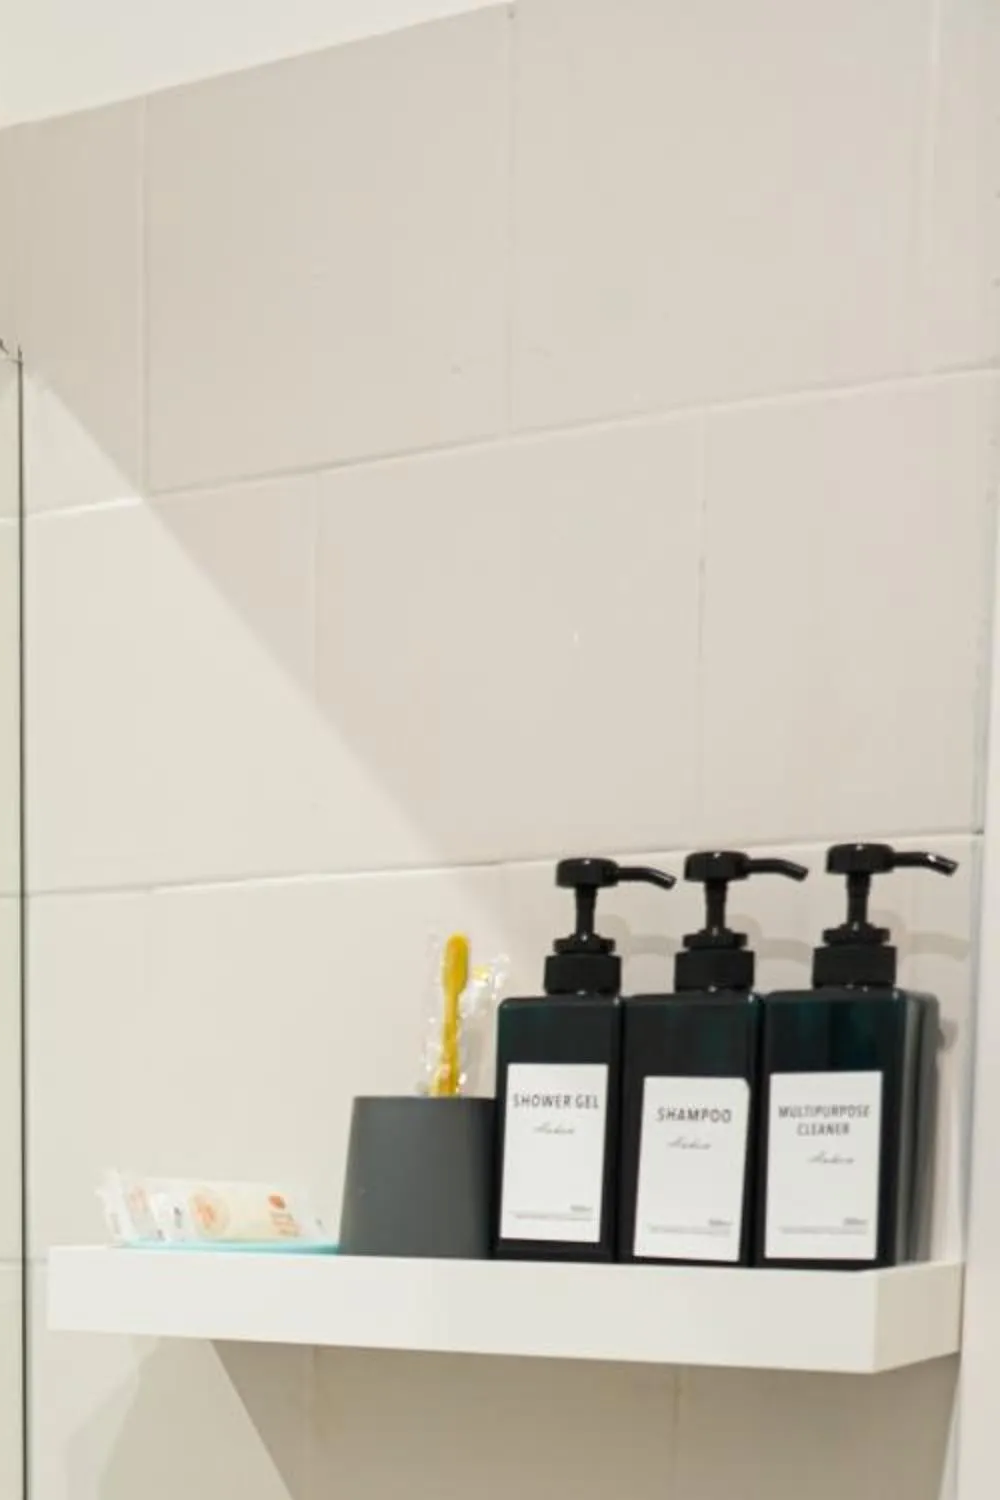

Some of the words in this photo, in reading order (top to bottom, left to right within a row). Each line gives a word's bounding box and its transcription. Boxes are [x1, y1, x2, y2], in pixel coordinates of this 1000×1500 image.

[512, 1092, 571, 1110] SHOWER
[575, 1093, 600, 1110] GEL
[654, 1106, 733, 1124] SHAMPOO
[777, 1103, 872, 1119] MULTIPURPOSE
[796, 1121, 851, 1137] CLEANER
